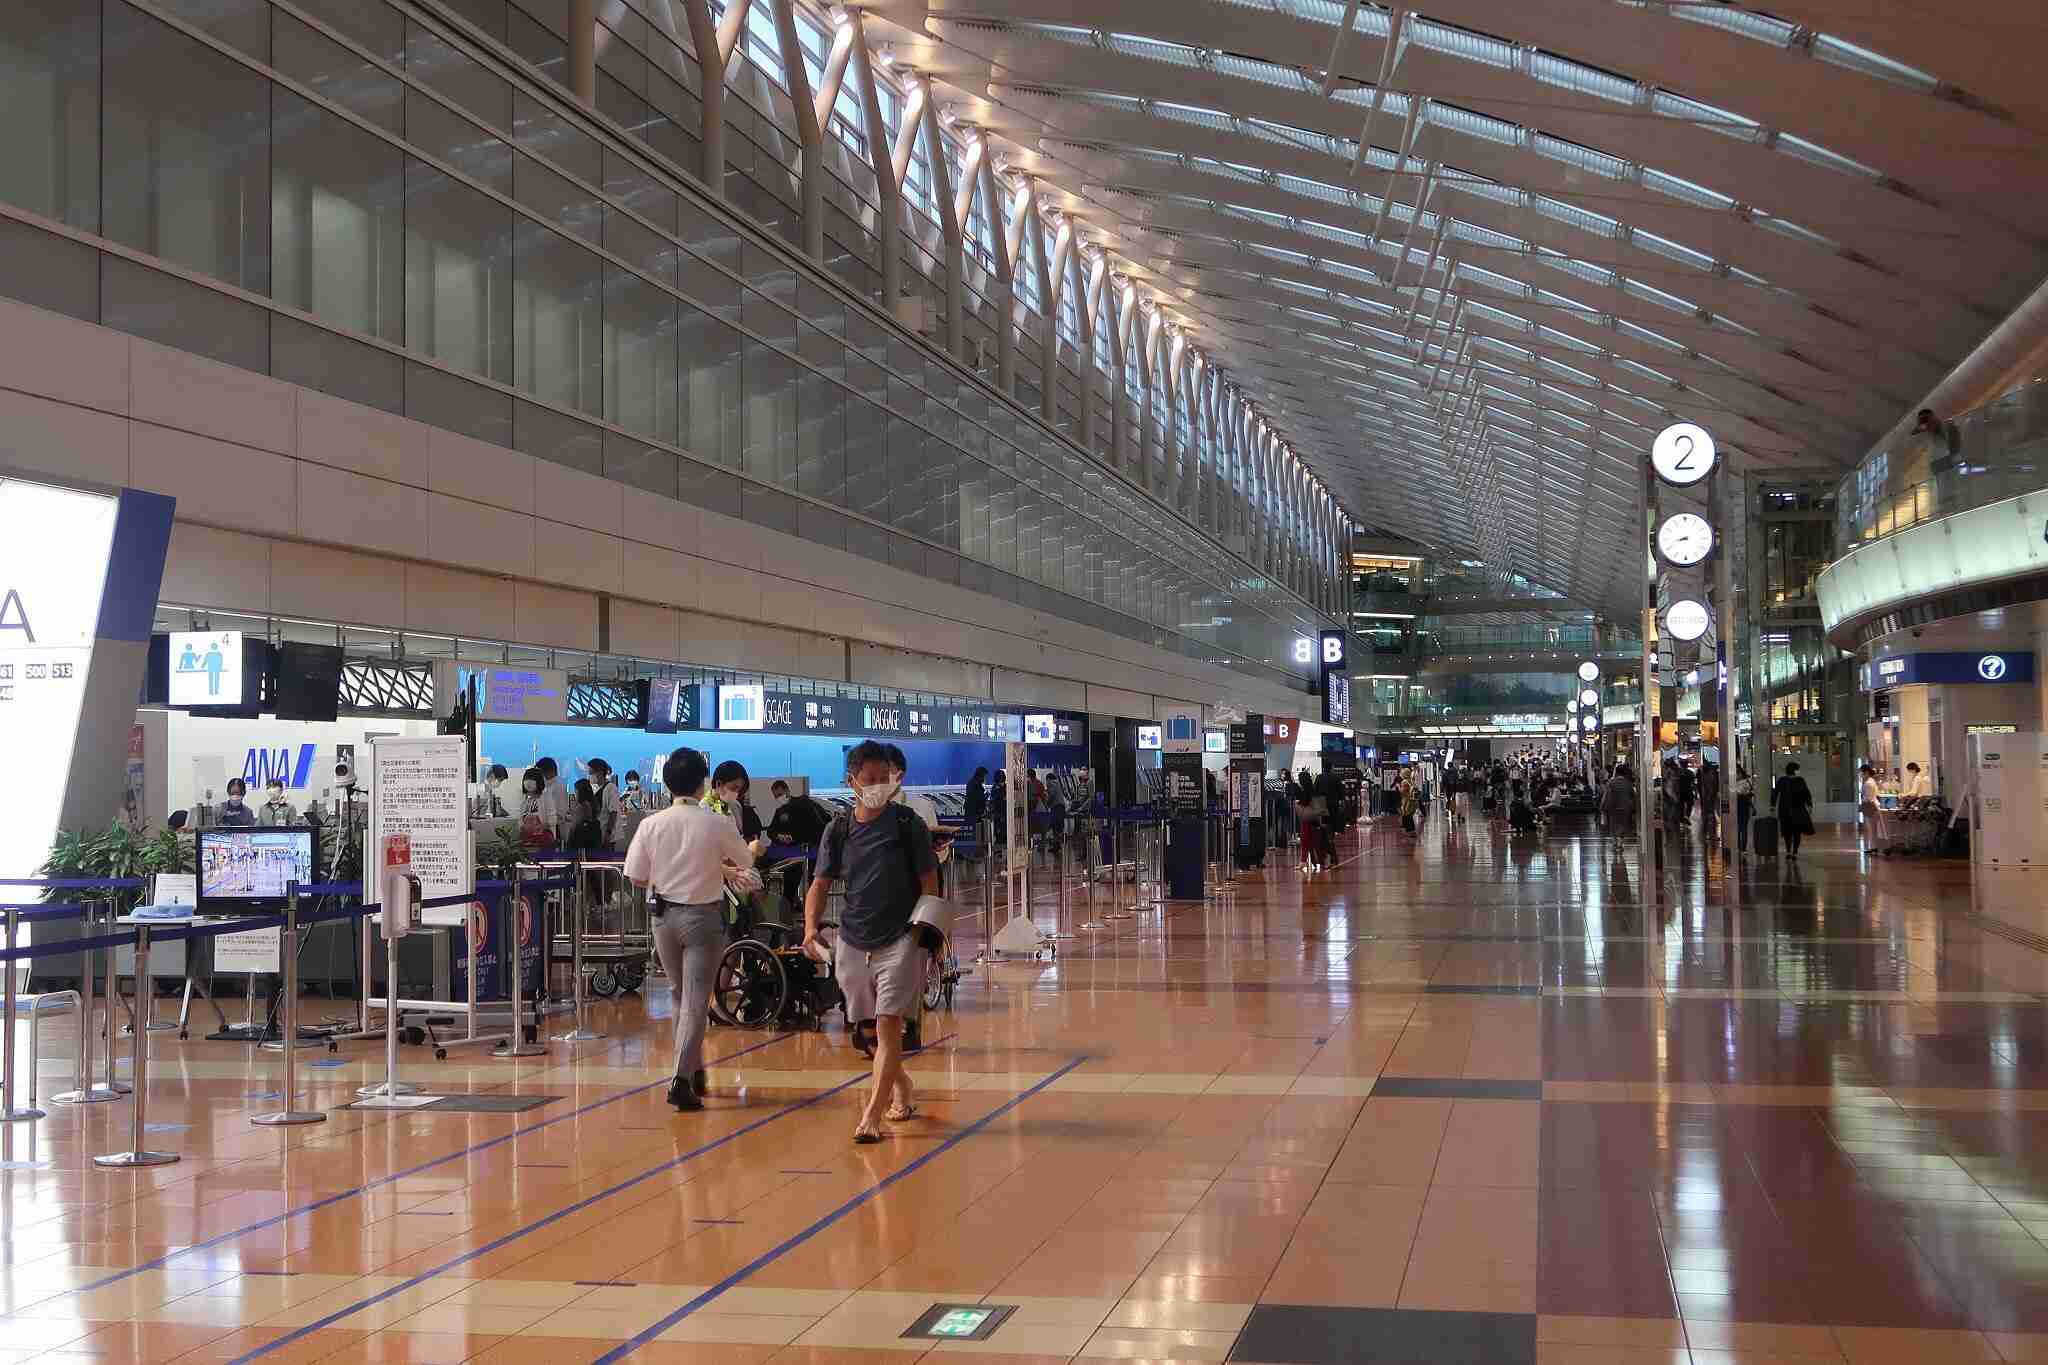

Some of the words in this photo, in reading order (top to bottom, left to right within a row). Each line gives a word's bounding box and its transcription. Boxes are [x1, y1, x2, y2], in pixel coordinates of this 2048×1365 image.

[1674, 435, 1695, 470] 2
[0, 589, 36, 643] A
[1323, 638, 1343, 662] B
[872, 708, 900, 730] BAGGAGE
[1279, 724, 1289, 738] B
[242, 748, 290, 788] ANA
